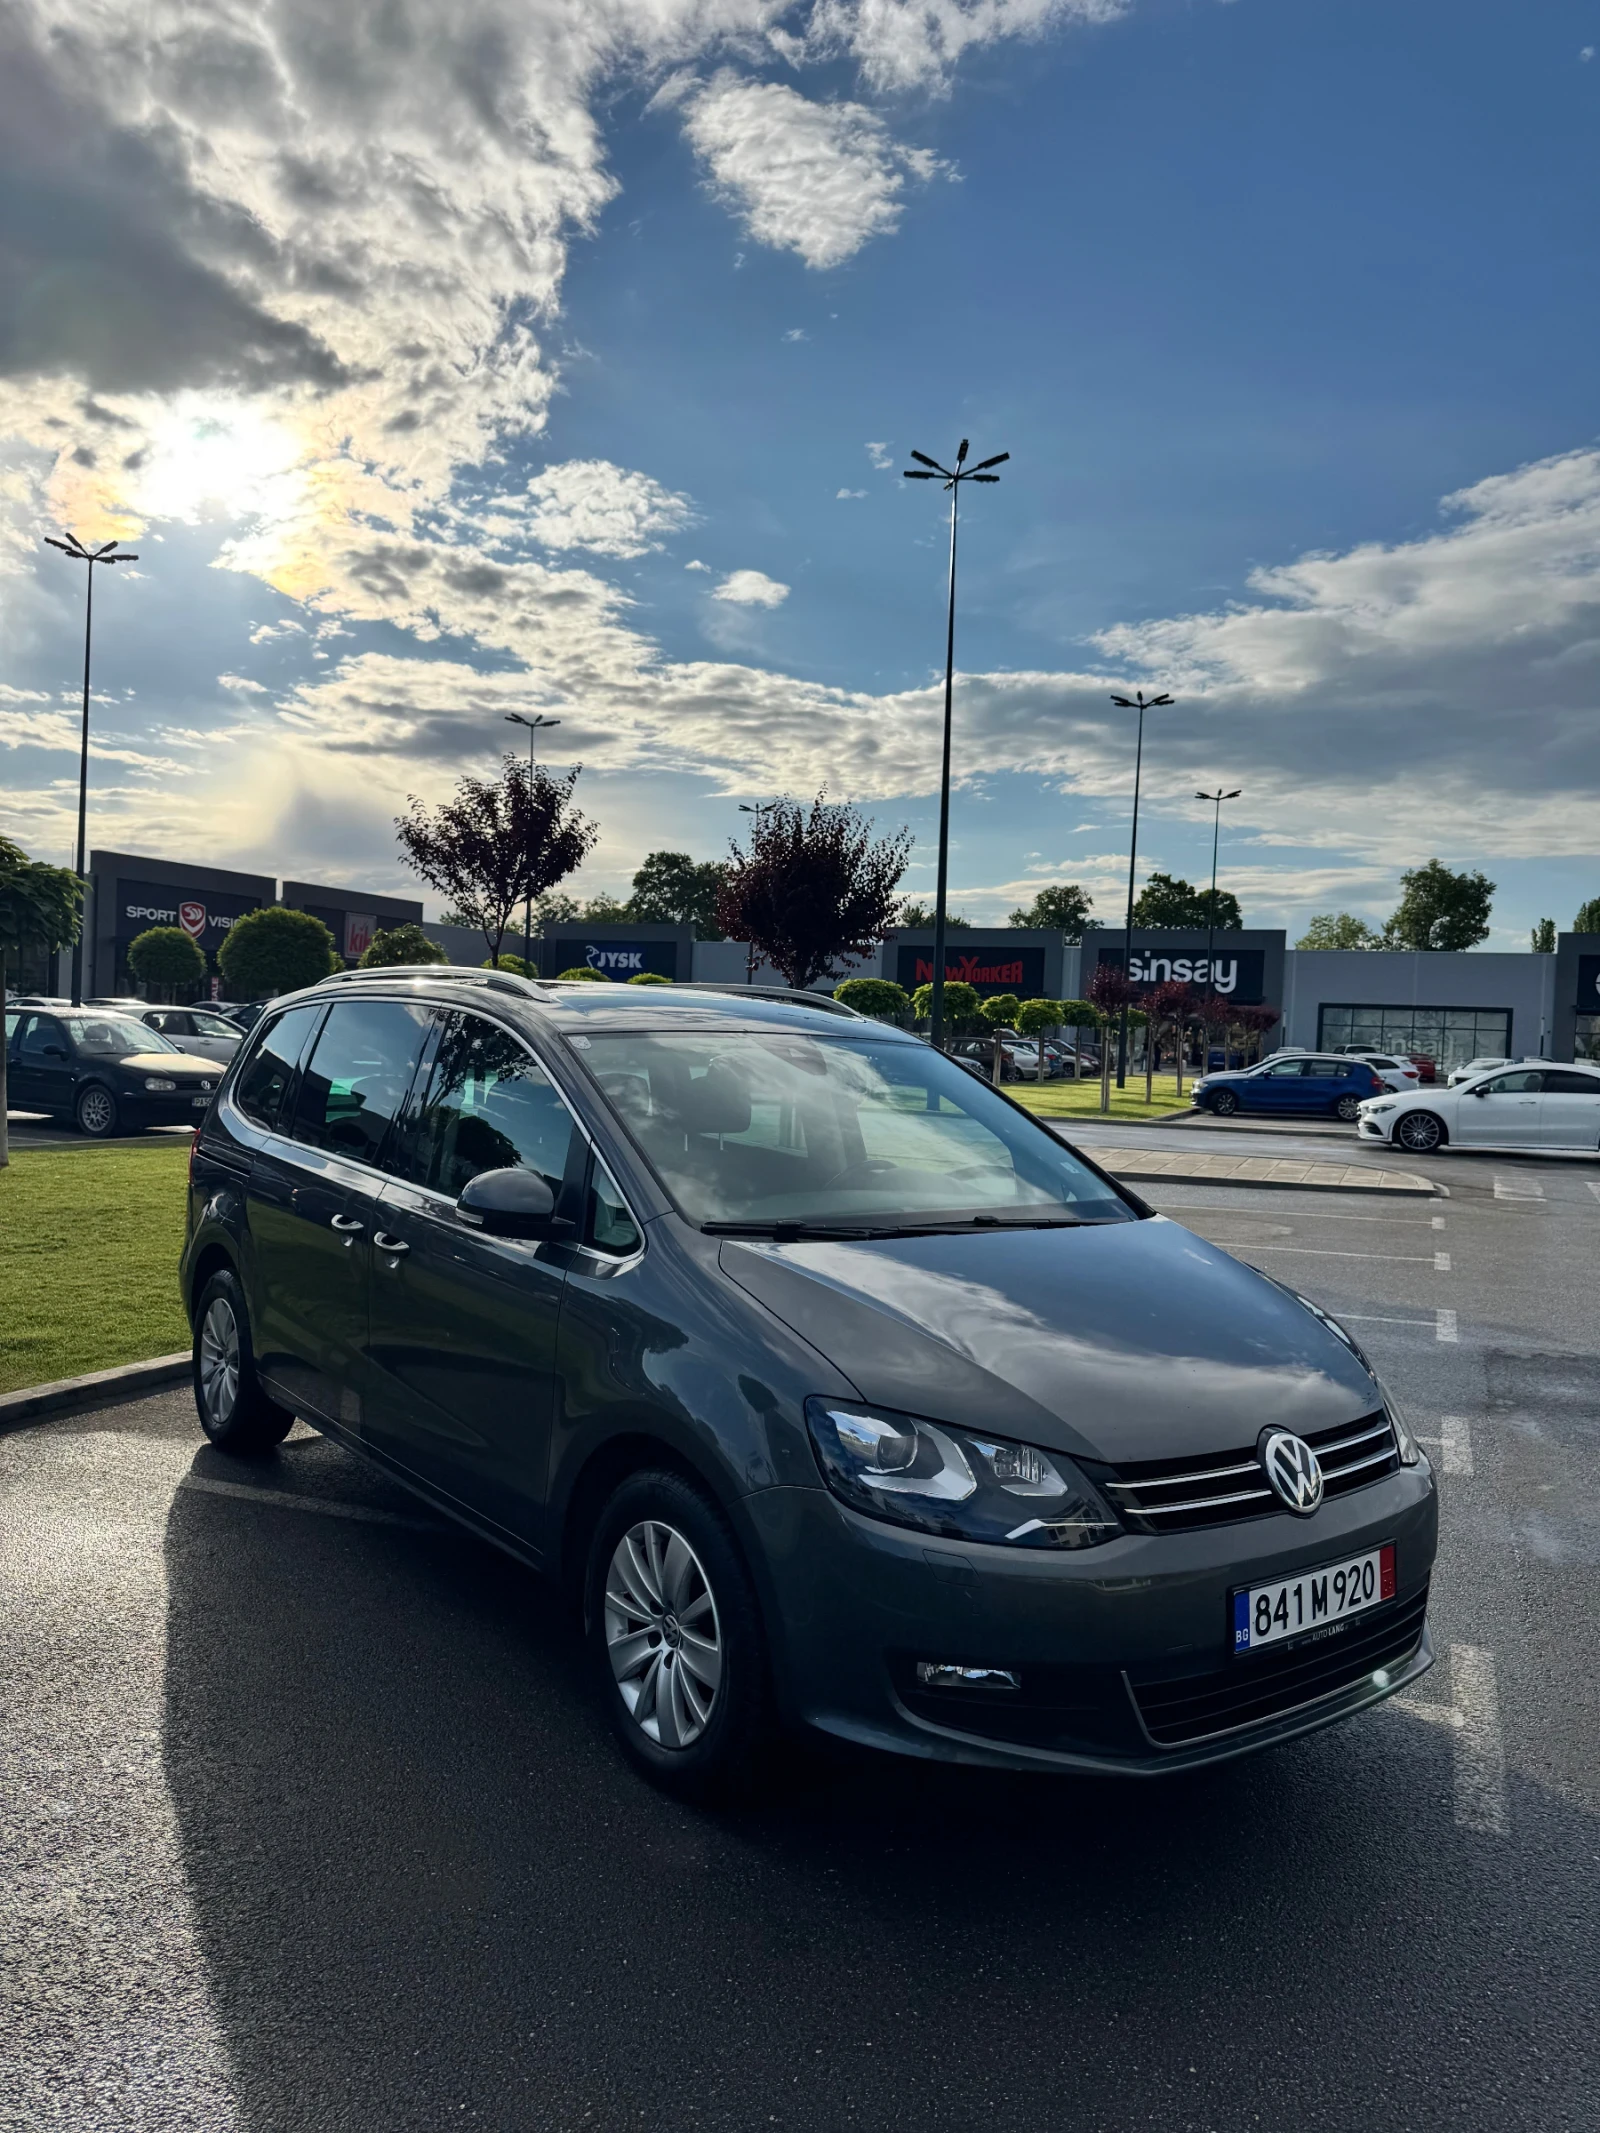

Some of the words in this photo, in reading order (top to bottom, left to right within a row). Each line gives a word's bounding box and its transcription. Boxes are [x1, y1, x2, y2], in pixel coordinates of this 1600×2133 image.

[126, 905, 177, 922] SPORT
[597, 952, 643, 969] JYSK
[1129, 950, 1238, 994] sinsay
[1236, 1628, 1249, 1643] BG
